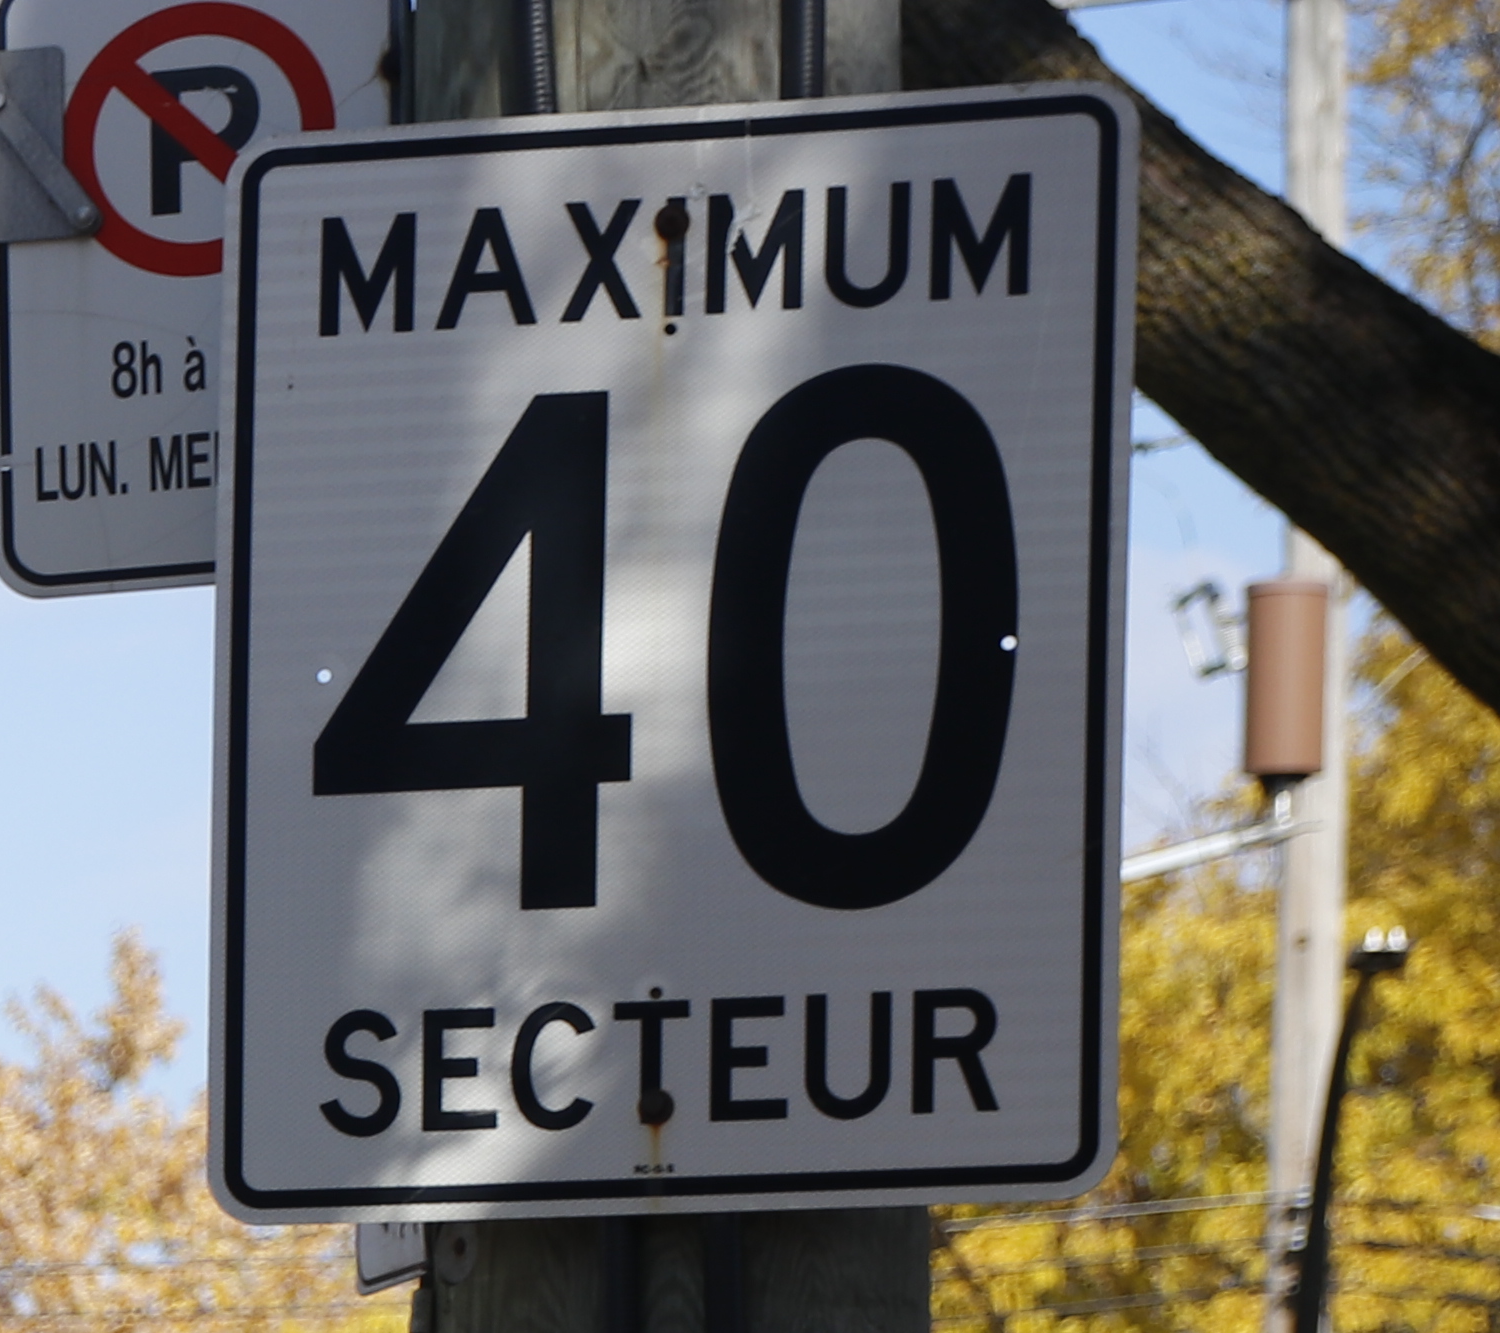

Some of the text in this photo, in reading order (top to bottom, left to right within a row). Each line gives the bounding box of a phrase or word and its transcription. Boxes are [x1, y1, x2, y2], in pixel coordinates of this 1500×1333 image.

[317, 172, 1033, 337] MAXIMUM
[111, 335, 206, 399] 8h à
[34, 430, 219, 502] LUN. ME
[311, 362, 1021, 911] 40
[317, 986, 1001, 1138] SECTEUR
